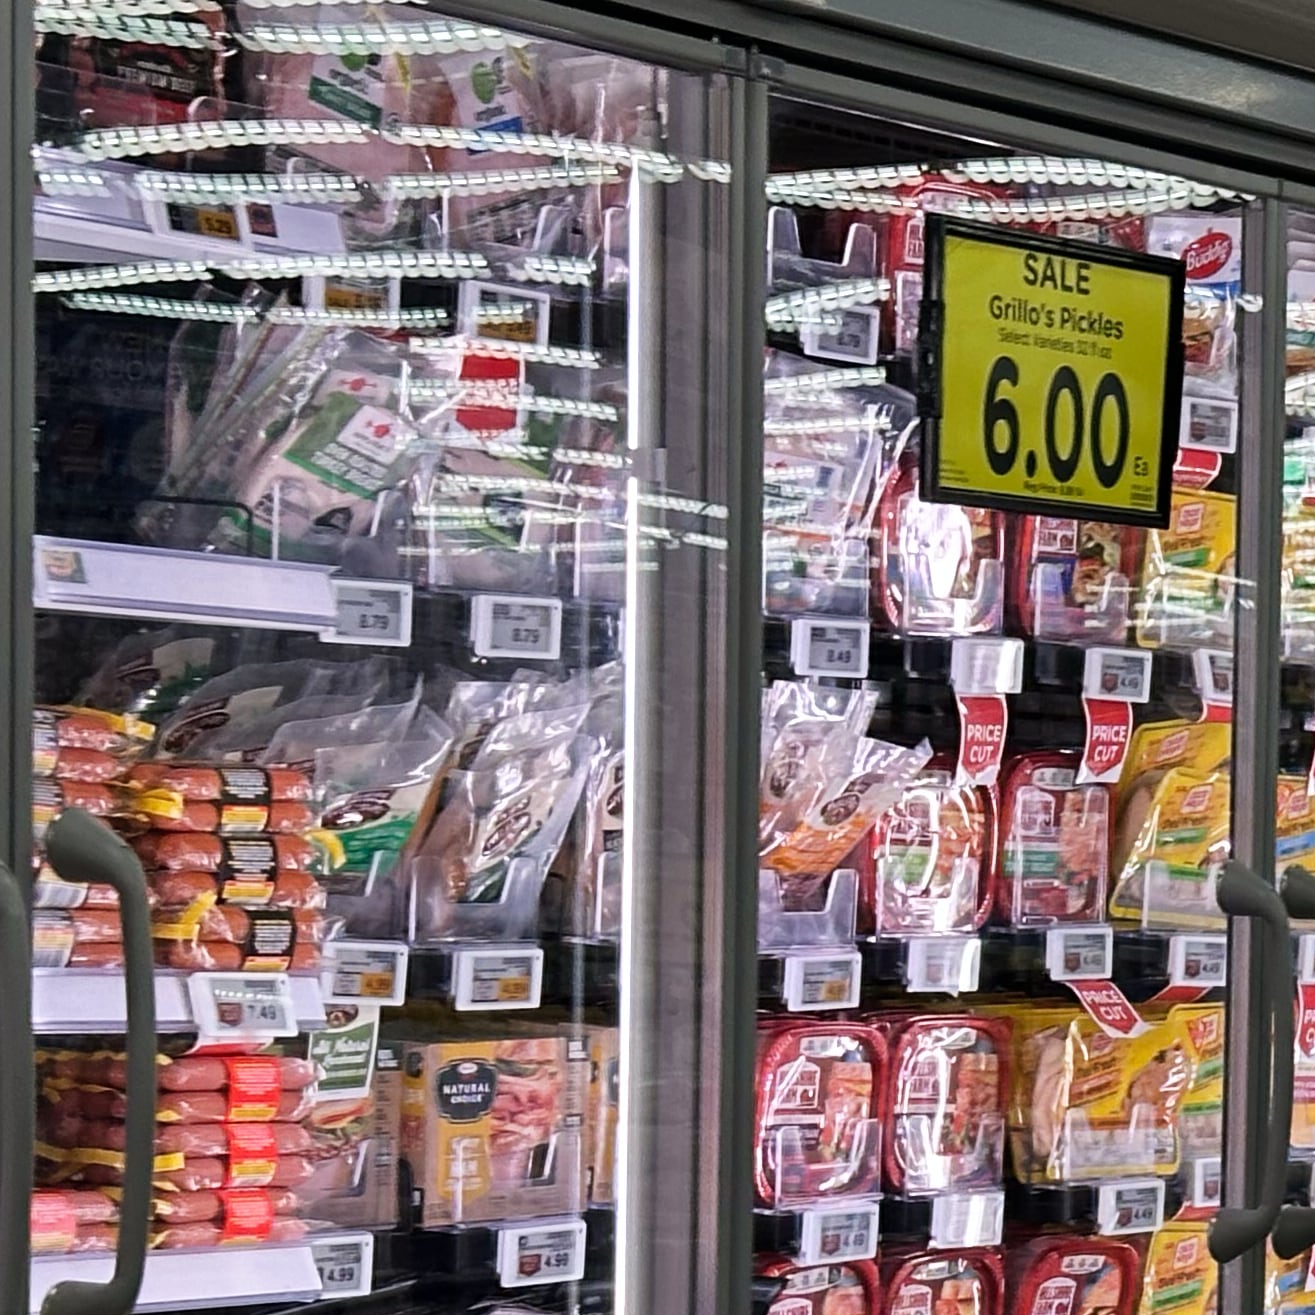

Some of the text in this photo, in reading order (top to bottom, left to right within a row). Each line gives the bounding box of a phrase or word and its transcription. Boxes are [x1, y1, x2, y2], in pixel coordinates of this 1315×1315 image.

[1023, 252, 1091, 296] SALE
[989, 295, 1124, 340] Grillo's Pickles
[982, 355, 1131, 488] 6.00
[966, 724, 1001, 742] PRICE
[1091, 724, 1126, 743] PRICE
[969, 745, 995, 763] CUT
[1093, 745, 1119, 761] CUT
[1082, 989, 1119, 1005] PRICE
[1100, 1005, 1126, 1021] CUT
[442, 1082, 491, 1094] NATURAL
[450, 1093, 483, 1104] CHOICE
[543, 1251, 570, 1268] 4.99
